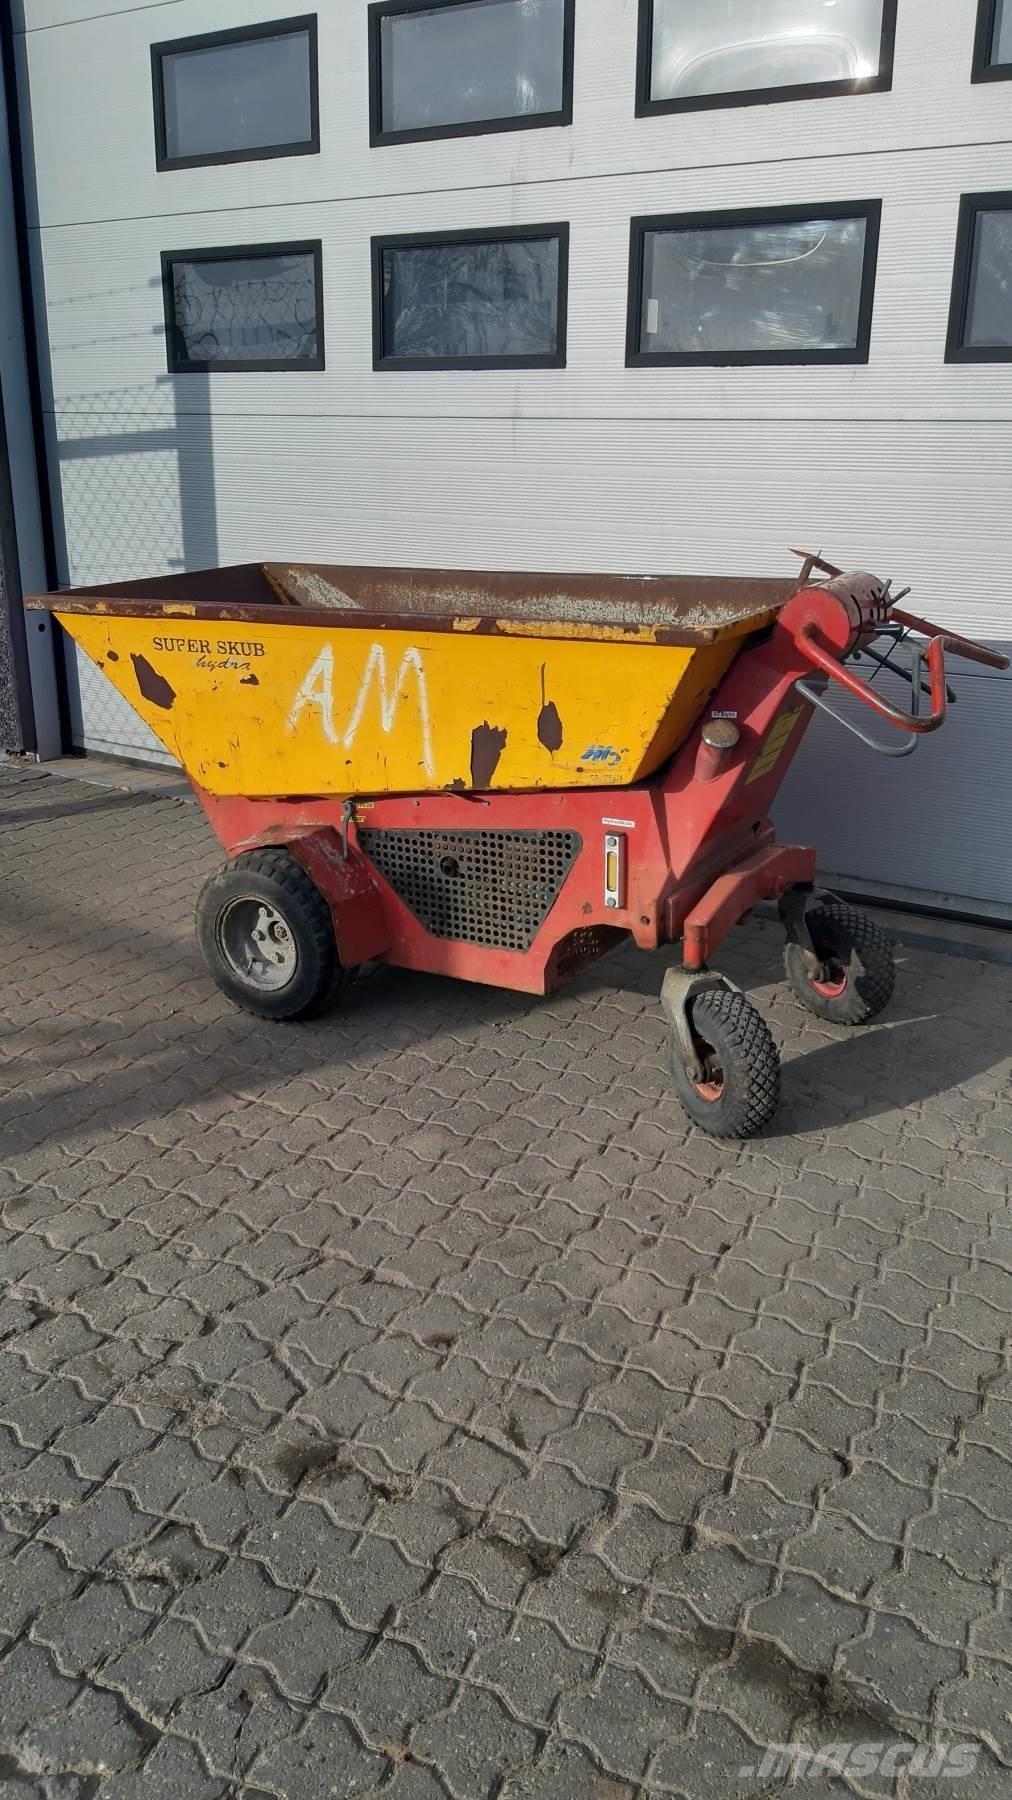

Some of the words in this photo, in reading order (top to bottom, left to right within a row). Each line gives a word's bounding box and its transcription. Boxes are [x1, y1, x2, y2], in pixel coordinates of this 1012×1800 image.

[152, 636, 212, 654] SUPER
[216, 640, 266, 657] SKUB
[286, 642, 436, 780] AM
